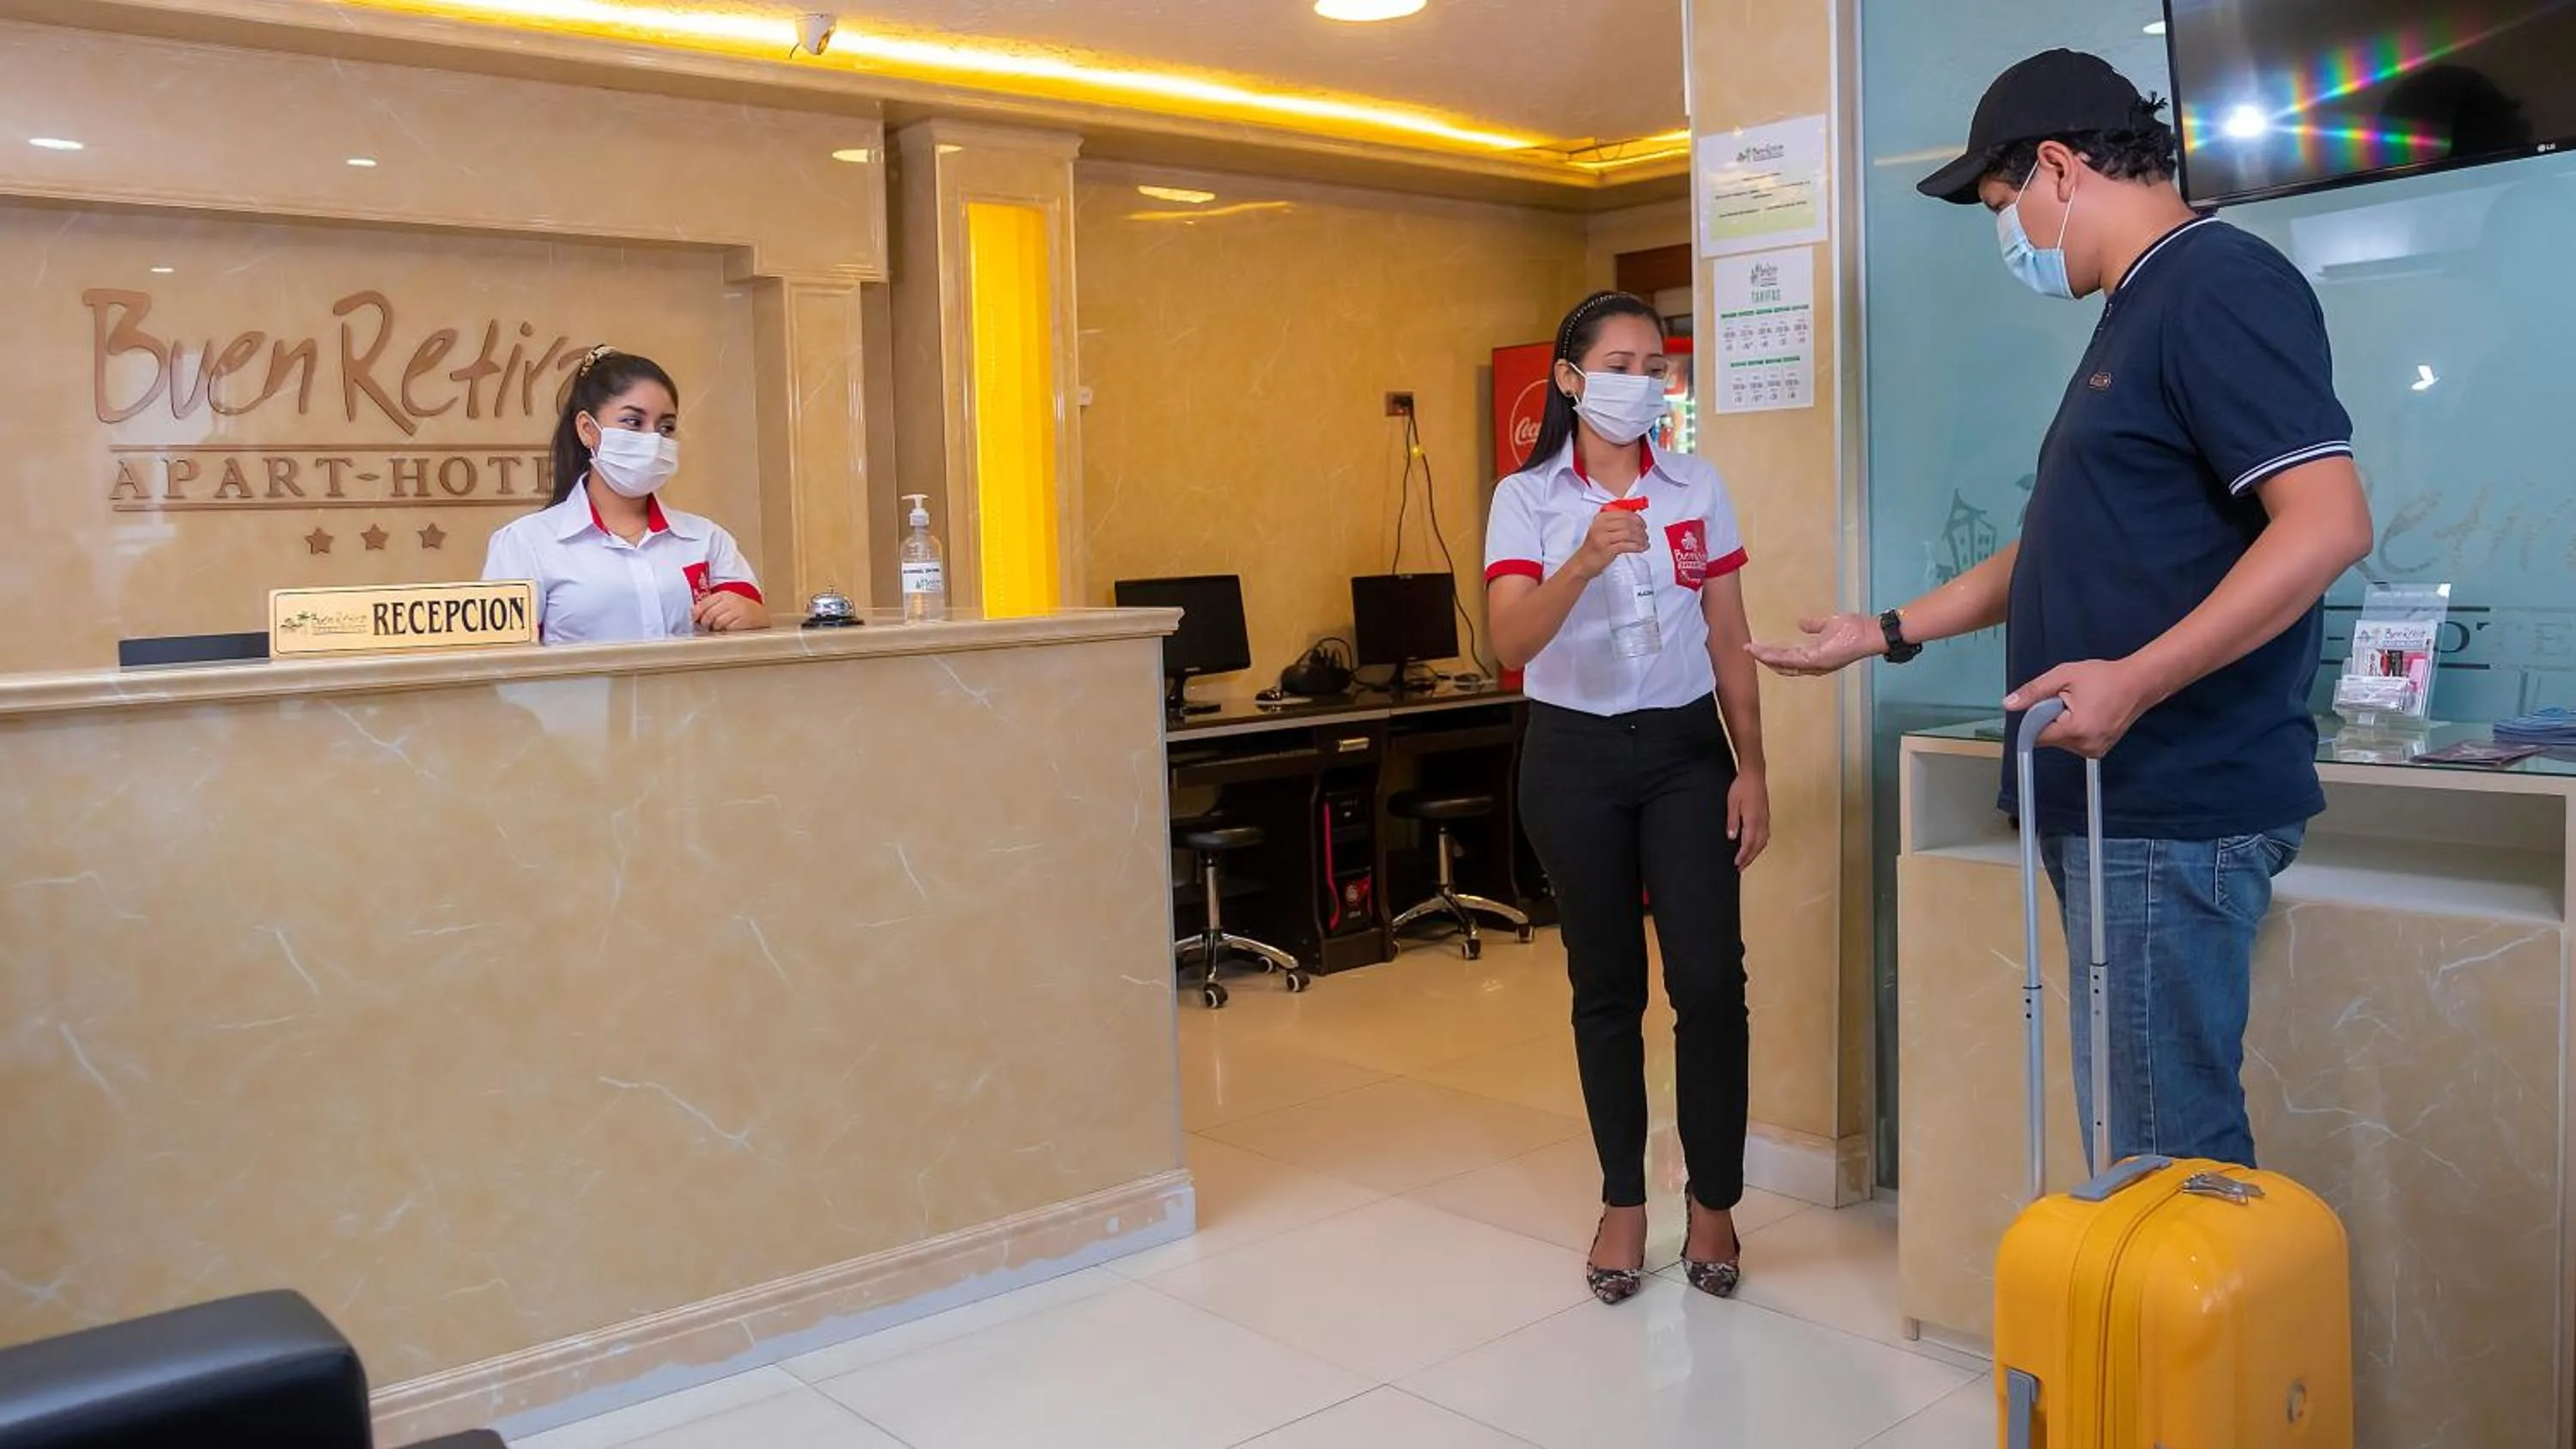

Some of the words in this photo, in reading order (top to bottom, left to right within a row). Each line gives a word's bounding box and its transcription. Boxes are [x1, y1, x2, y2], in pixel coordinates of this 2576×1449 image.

[82, 288, 317, 423] Buen
[109, 457, 551, 500] APART-HOT
[373, 597, 526, 636] RECEPCION
